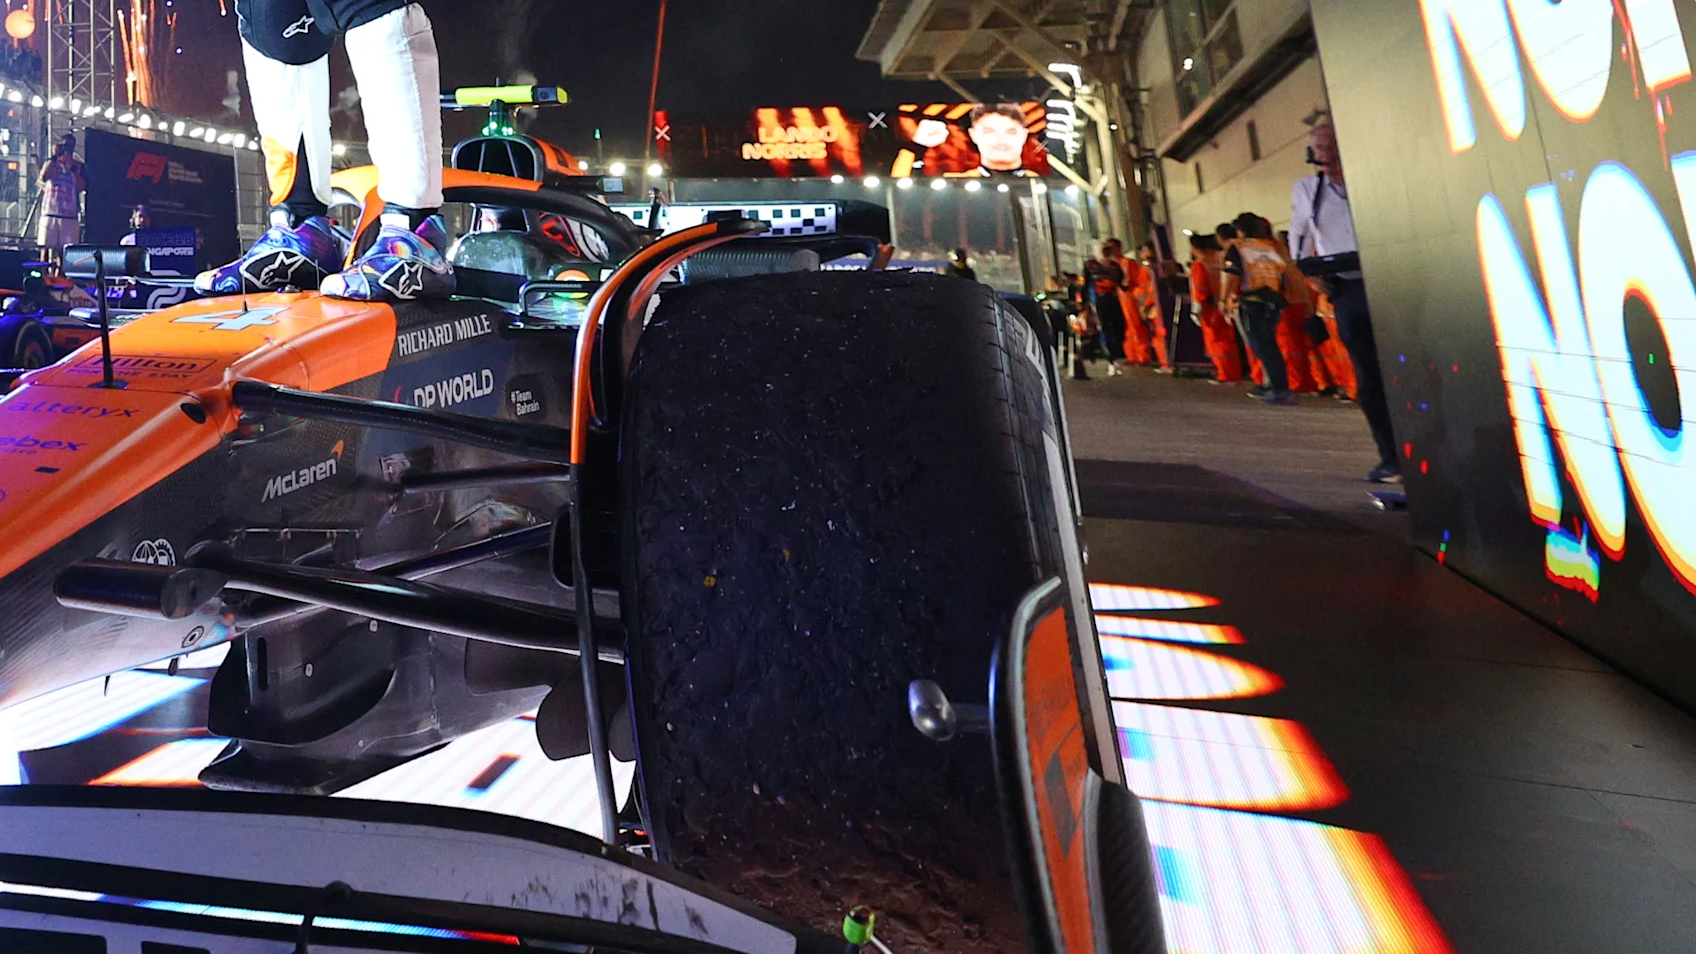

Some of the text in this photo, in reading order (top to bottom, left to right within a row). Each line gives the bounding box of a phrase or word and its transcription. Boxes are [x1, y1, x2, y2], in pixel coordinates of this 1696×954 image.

[758, 125, 839, 143] LANDO
[741, 142, 828, 160] NORRIS
[147, 247, 194, 256] NGAPORE
[172, 306, 291, 331] 4
[397, 313, 492, 357] RICHARD MILLE
[1475, 150, 1696, 596] NO
[436, 368, 494, 408] WORLD
[511, 390, 532, 404] #Team
[8, 402, 140, 419] alteryx
[516, 402, 540, 416] Bahrain
[261, 457, 337, 504] McLaren
